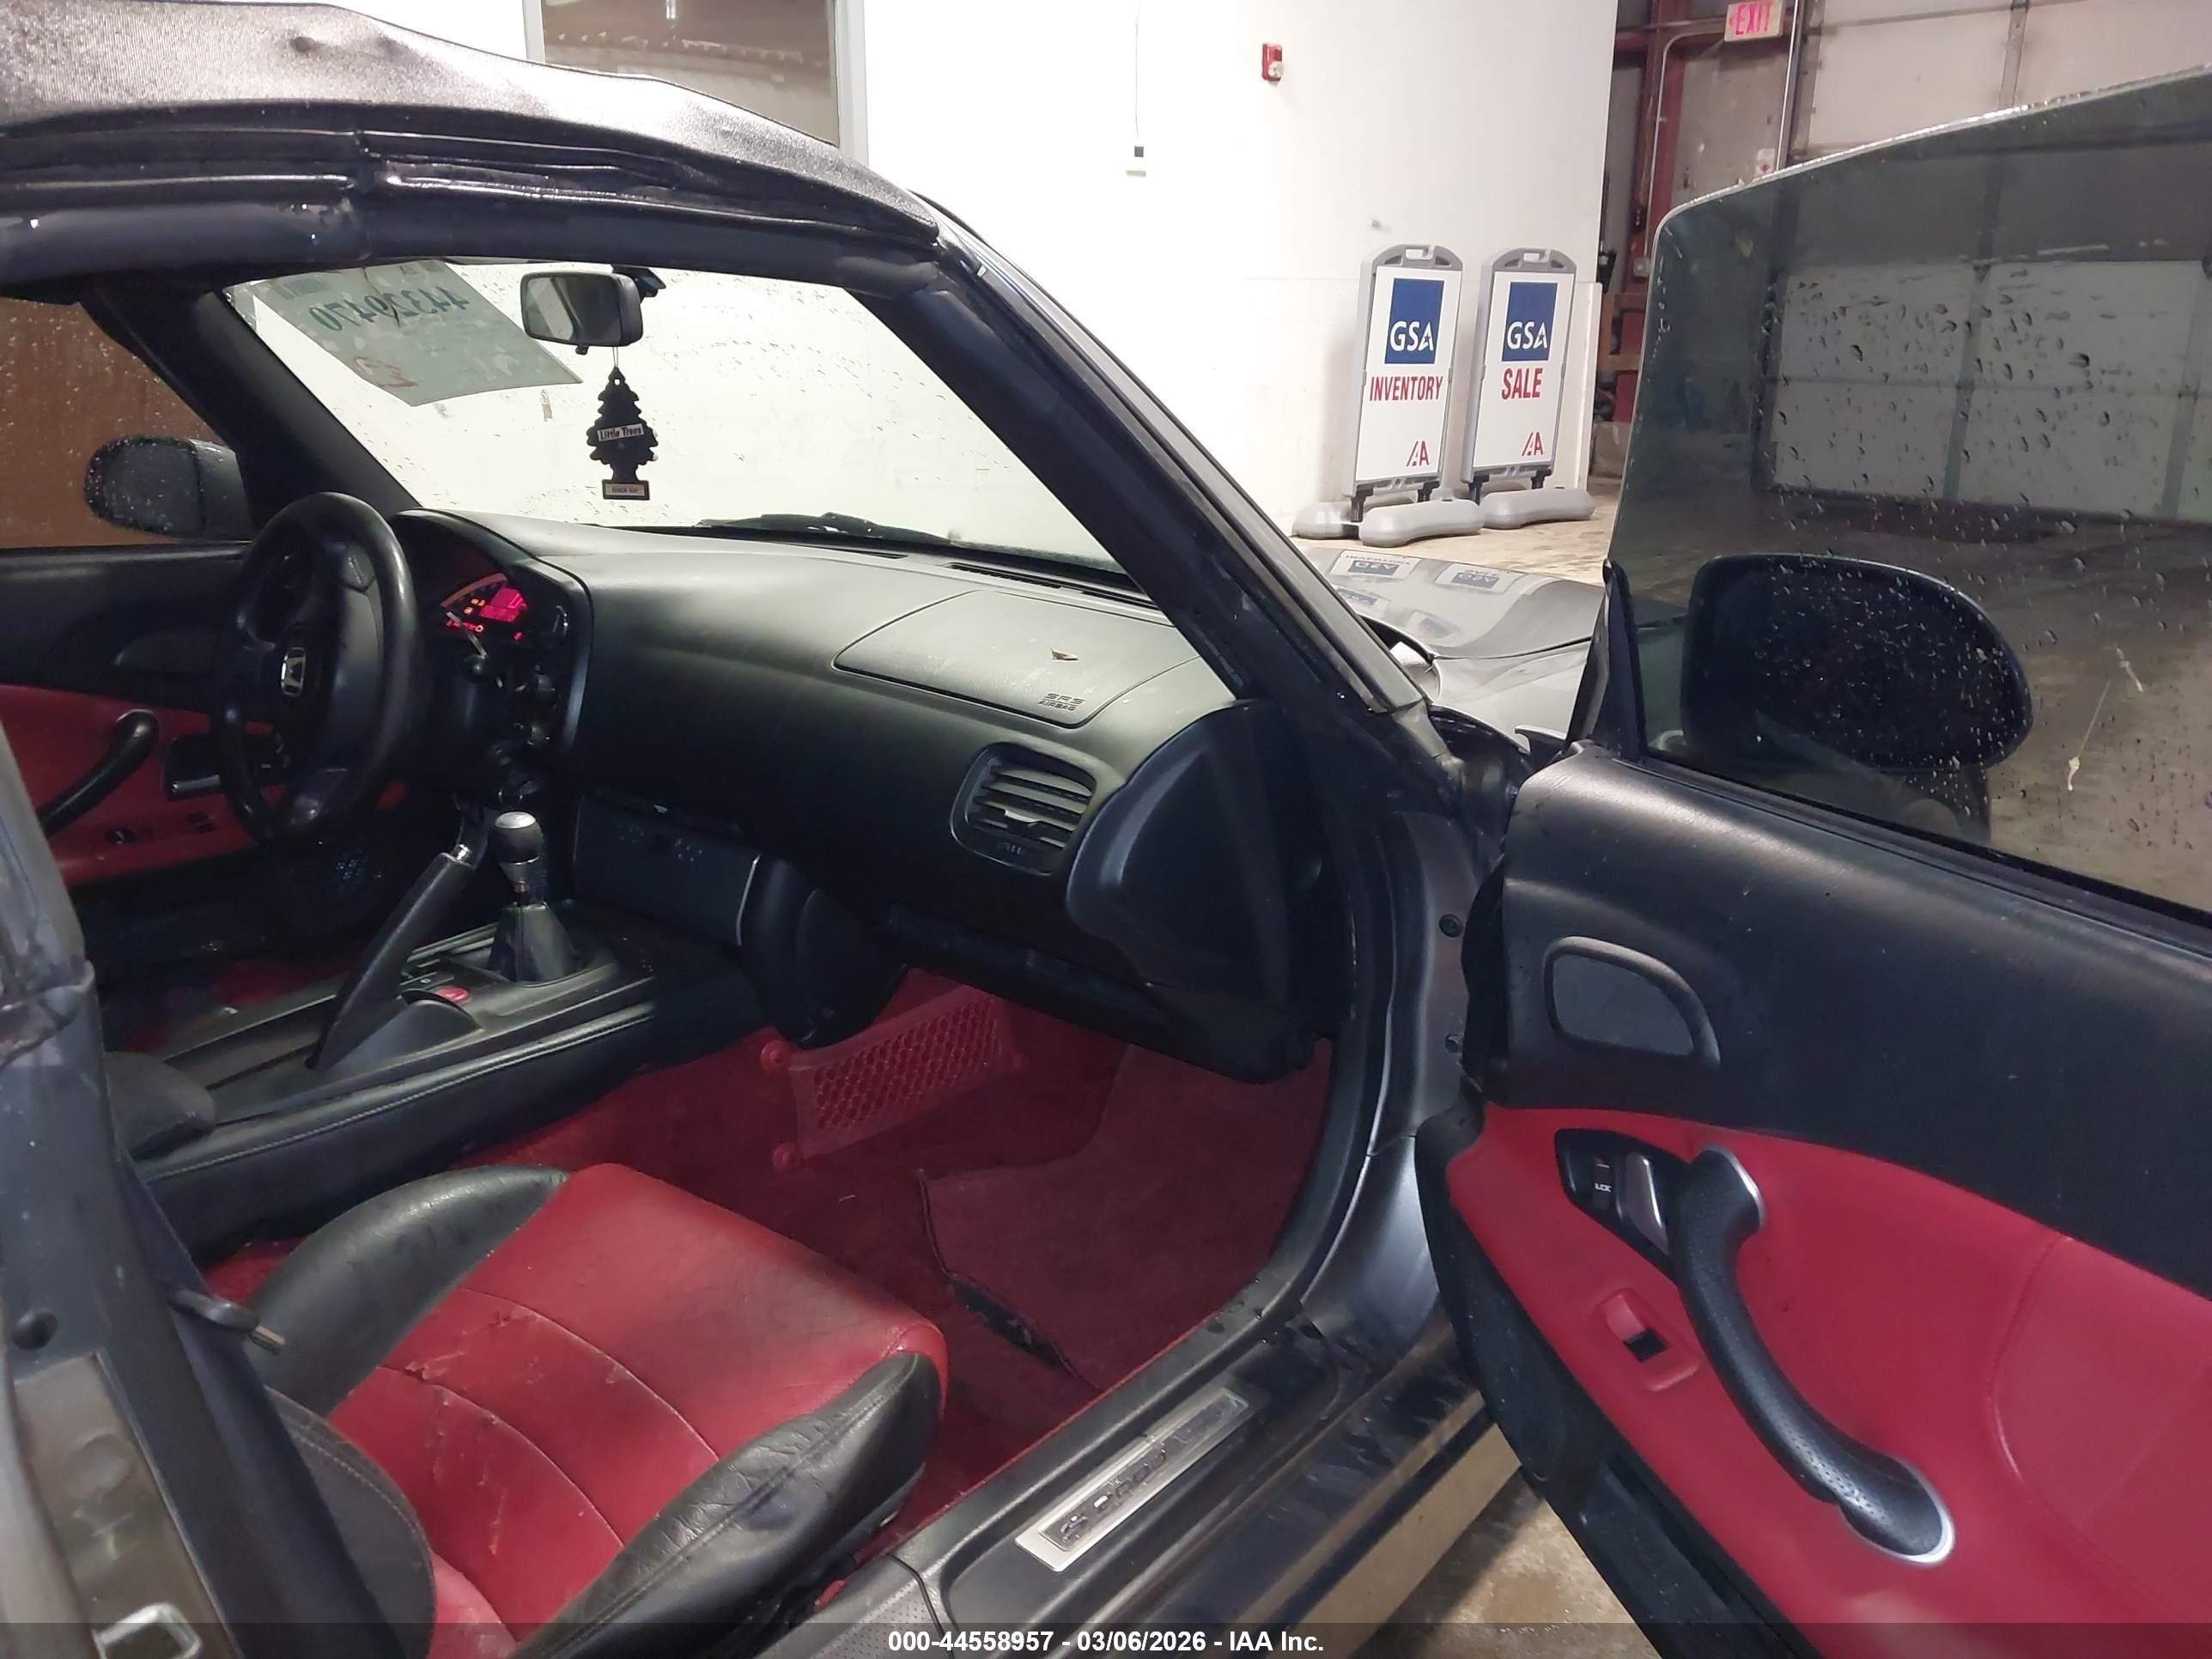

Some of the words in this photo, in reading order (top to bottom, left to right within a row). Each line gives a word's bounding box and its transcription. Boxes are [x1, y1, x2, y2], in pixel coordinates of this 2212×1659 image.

[1735, 2, 1772, 35] EXIT
[1389, 320, 1435, 351] GSA
[1507, 320, 1548, 349] GSA
[1369, 375, 1443, 402] INVENTORY
[1501, 368, 1544, 400] SALE
[1037, 700, 1077, 712] AIRBAG
[1044, 692, 1086, 705] SRS
